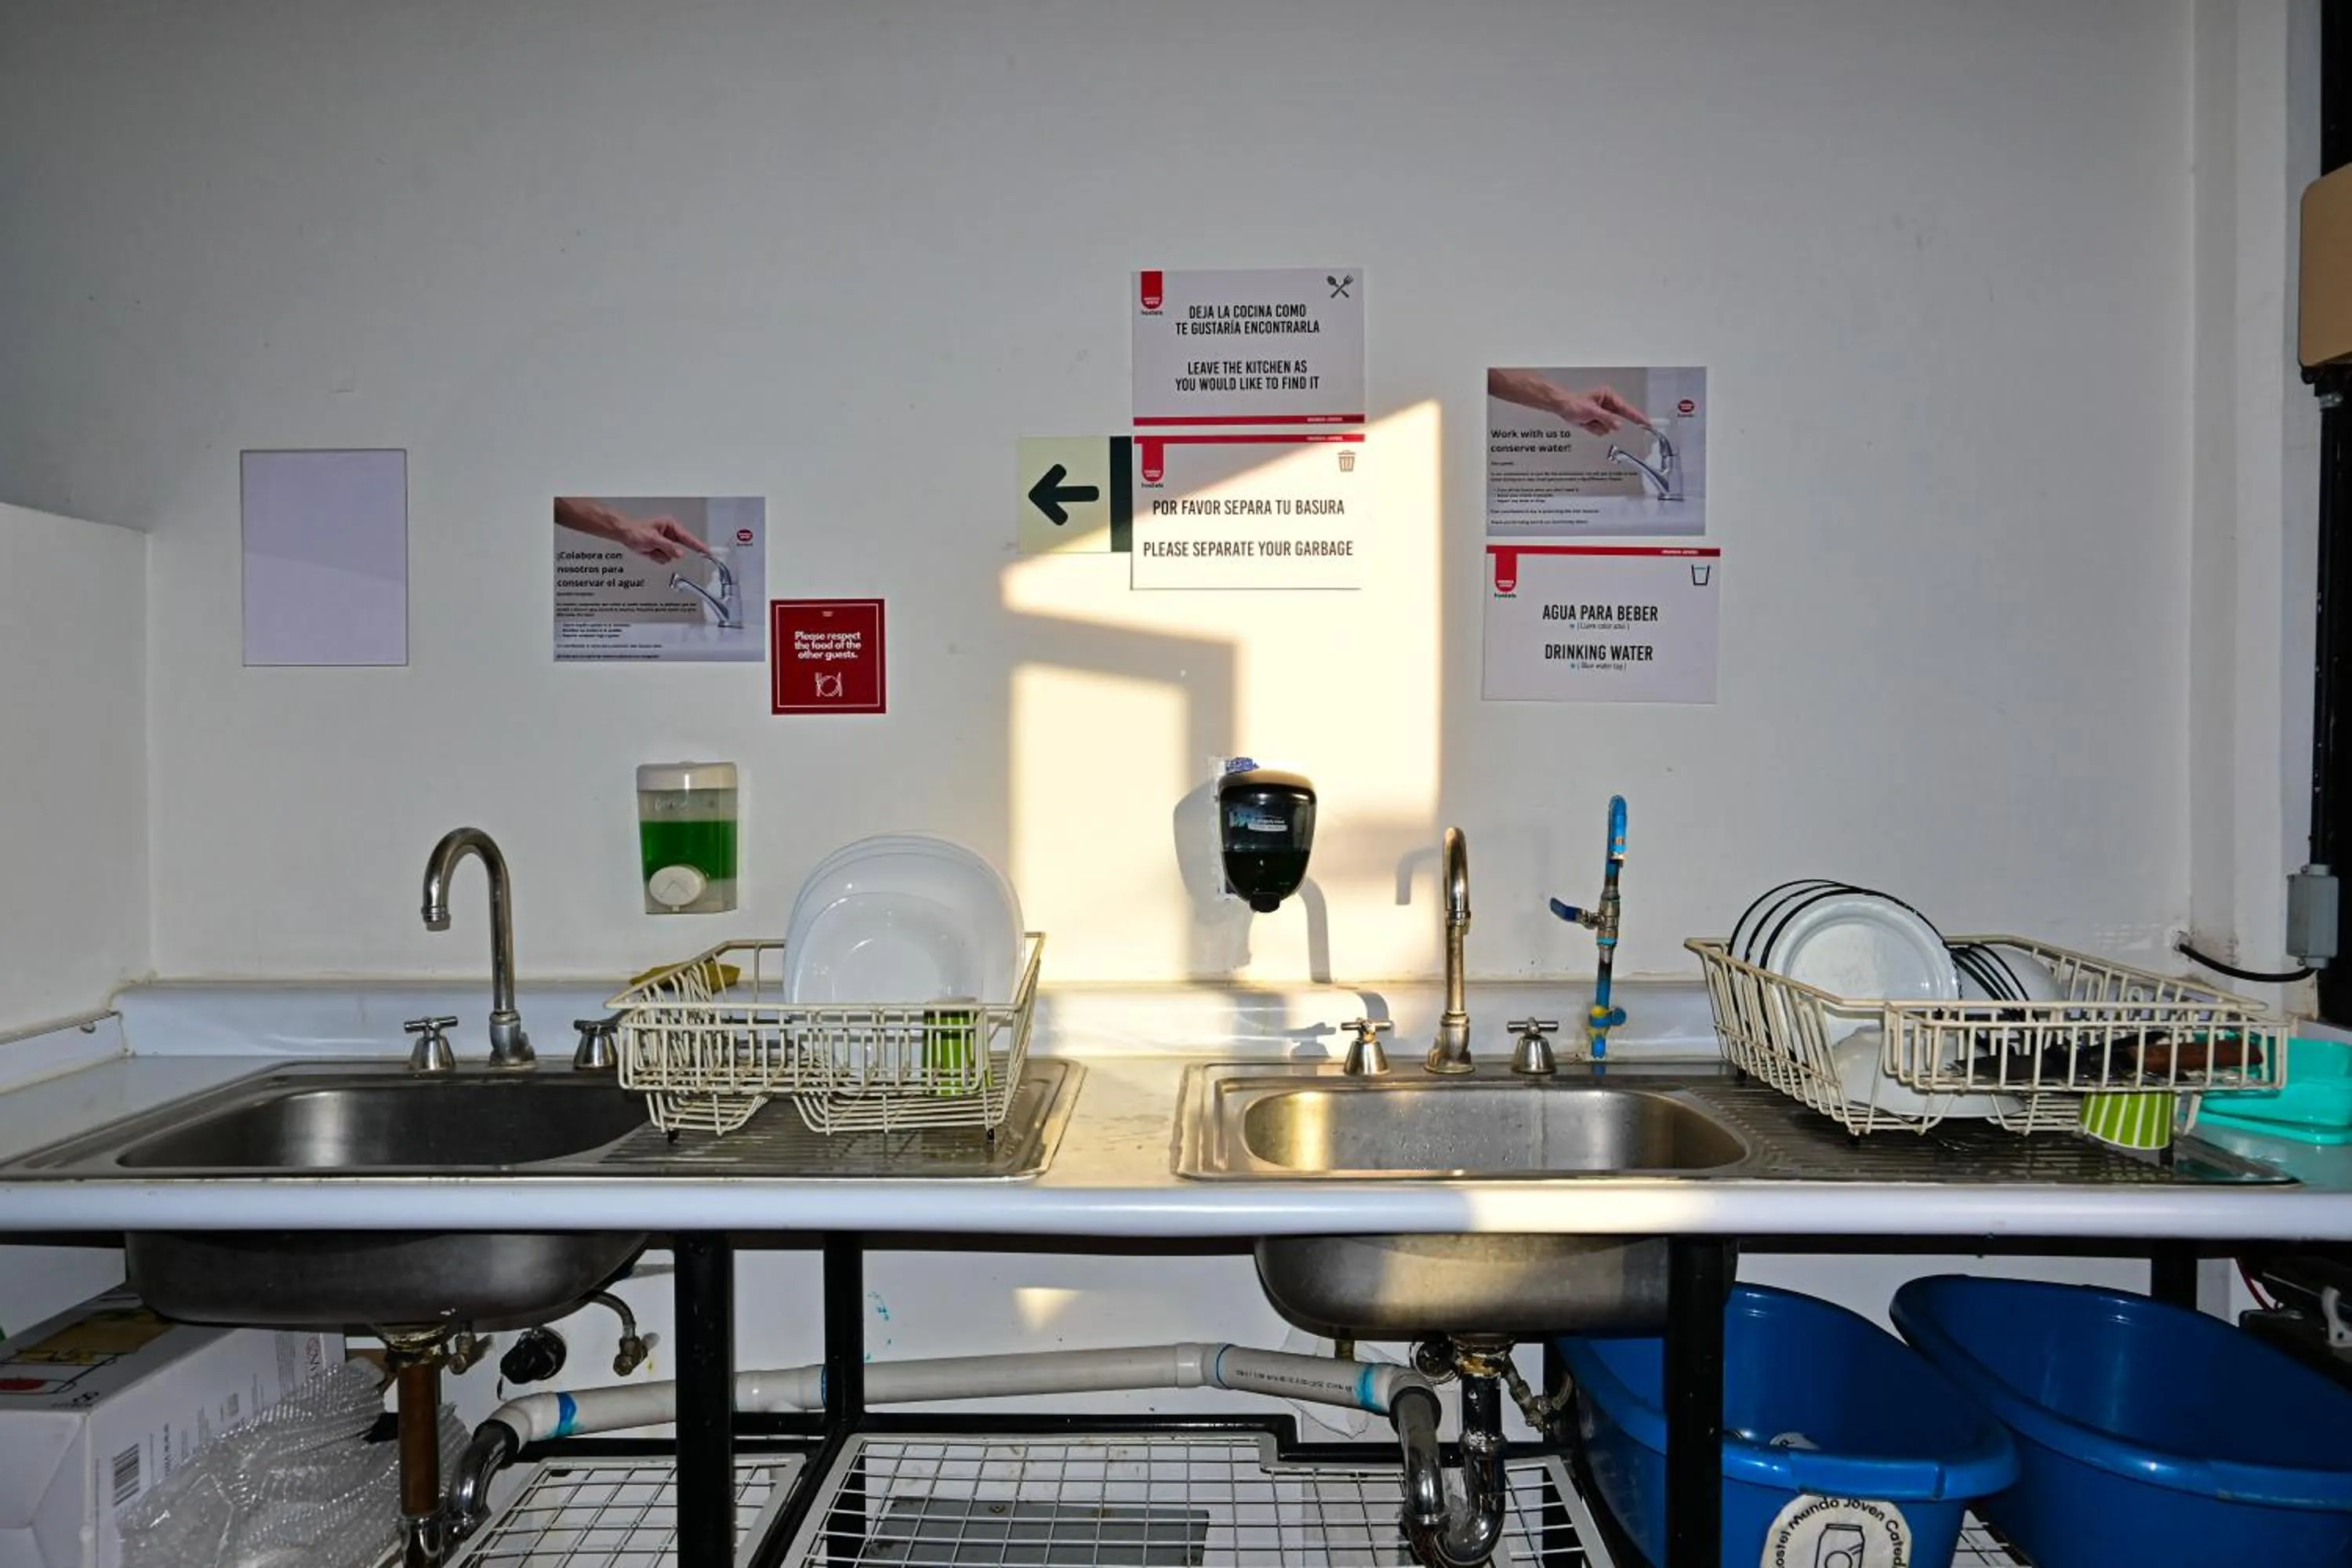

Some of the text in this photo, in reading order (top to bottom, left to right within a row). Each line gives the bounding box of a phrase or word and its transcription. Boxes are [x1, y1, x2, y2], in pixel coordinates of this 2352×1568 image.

[1189, 304, 1306, 319] DEJA LA COCINA COMO
[1176, 320, 1319, 335] TE GUSTARÍA ENCONTRARLA
[1188, 360, 1308, 375] LEAVE THE KITCHEN AS
[1176, 376, 1320, 391] YOU WOULD LIKE TO FIND IT
[1490, 430, 1571, 439] Work with us to
[1152, 499, 1345, 515] POR FAVOR SEPARA TU BASURA
[557, 551, 603, 561] ¡Colabora
[1143, 540, 1354, 557] PLEASE SEPARATE YOUR GARBAGE
[601, 566, 624, 575] para
[557, 579, 604, 587] conservar
[606, 578, 617, 587] el
[1542, 604, 1659, 622] AGUA PARA BEBER
[794, 630, 862, 642] Please respect
[794, 639, 862, 650] the food of the
[797, 650, 858, 661] other guests.
[1544, 644, 1653, 661] DRINKING WATER
[1775, 1530, 1791, 1568] ostel
[1788, 1496, 1840, 1530] Mundo
[1886, 1519, 1908, 1568] Cated
